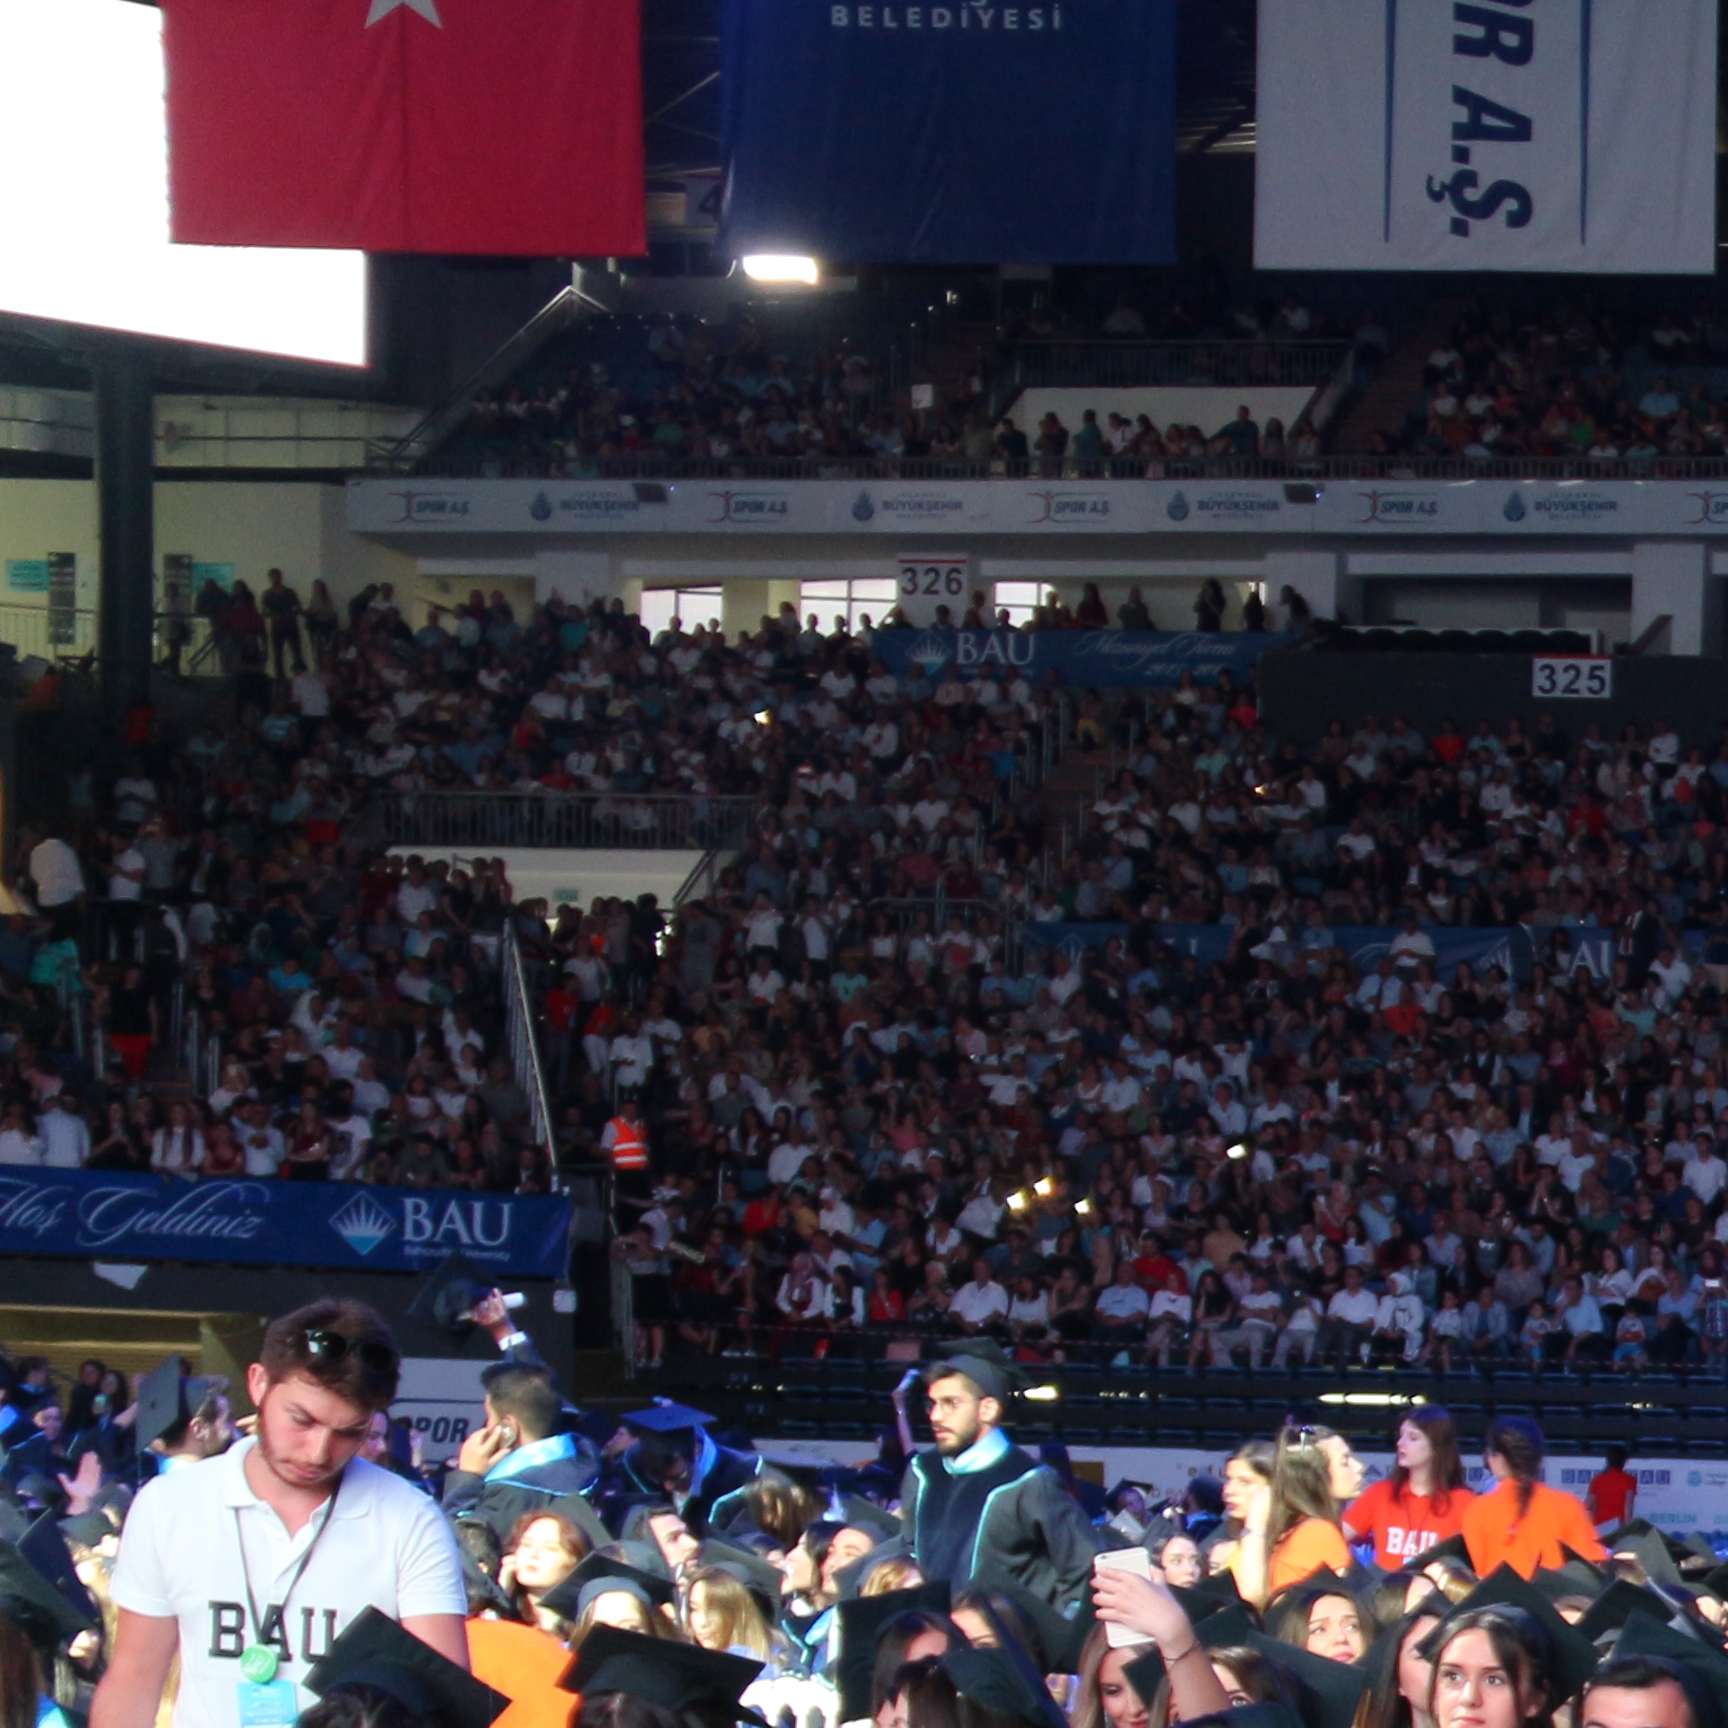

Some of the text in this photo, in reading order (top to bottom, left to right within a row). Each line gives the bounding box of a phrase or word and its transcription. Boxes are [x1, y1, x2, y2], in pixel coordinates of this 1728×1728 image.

[831, 3, 1061, 30] BELEDİYESİ
[1452, 0, 1534, 67] R
[901, 567, 963, 596] 326
[957, 631, 1036, 665] BAU
[1538, 664, 1606, 695] 325
[1568, 937, 1610, 980] AU
[75, 1181, 271, 1247] Geldiniz
[400, 1196, 514, 1246] BAU
[1386, 1526, 1440, 1556] BAU
[208, 1601, 337, 1663] BAU
